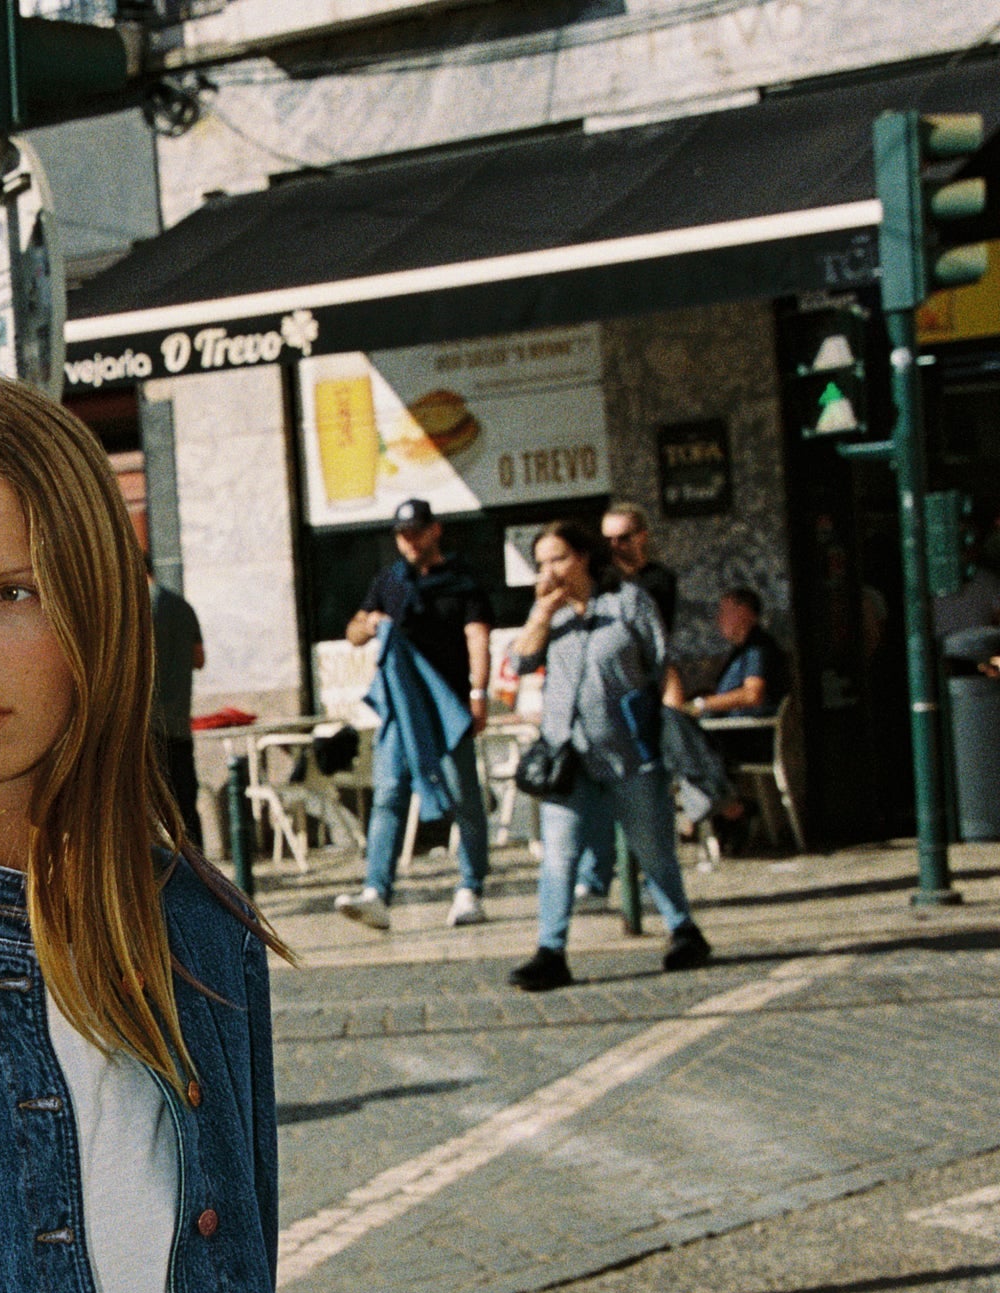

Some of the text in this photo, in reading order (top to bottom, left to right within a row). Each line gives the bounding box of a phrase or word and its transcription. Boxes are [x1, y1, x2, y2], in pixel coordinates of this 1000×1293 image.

[160, 332, 191, 373] O
[195, 328, 282, 368] Trevo
[498, 445, 598, 488] O TREVO
